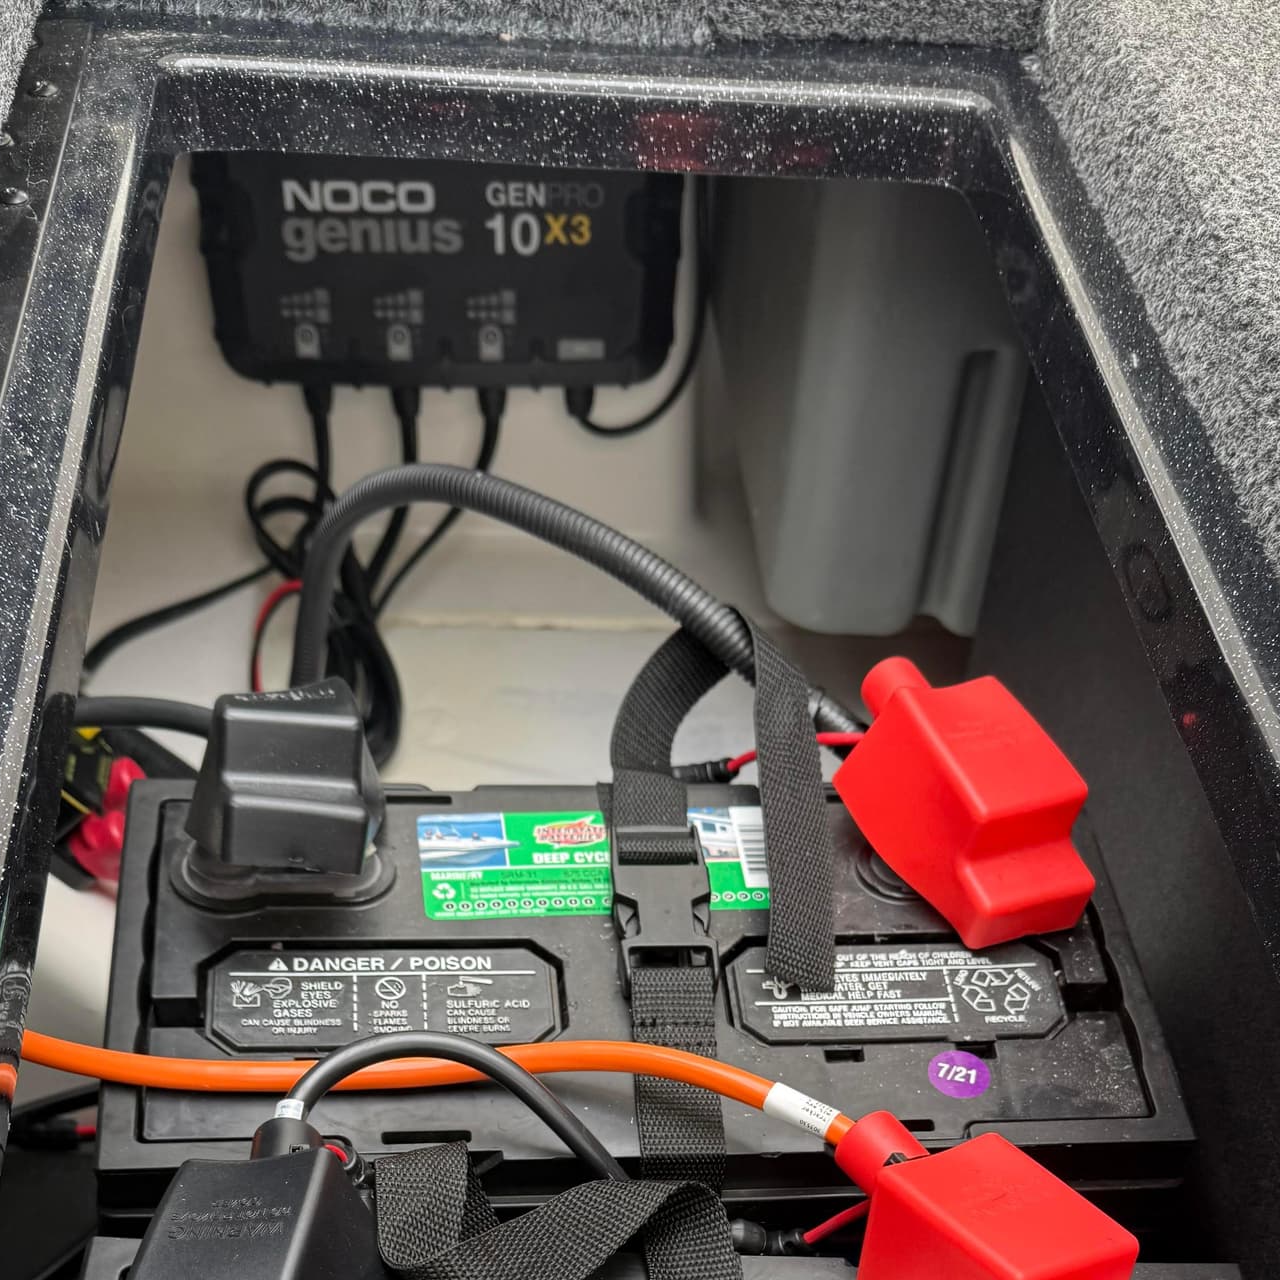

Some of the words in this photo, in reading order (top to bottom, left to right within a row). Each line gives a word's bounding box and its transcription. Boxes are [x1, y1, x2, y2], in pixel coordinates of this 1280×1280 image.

[282, 180, 435, 213] NOCO
[282, 217, 462, 262] genius
[533, 853, 569, 864] DEEP
[837, 954, 854, 962] OUT
[870, 953, 886, 961] THE
[889, 952, 915, 960] REACH
[293, 957, 384, 971] DANGER
[410, 957, 492, 970] POISON
[897, 959, 919, 967] CAPS
[835, 974, 859, 982] EYES
[862, 972, 927, 981] IMMEDIATELY
[301, 981, 343, 990] SHIELD
[869, 982, 888, 990] GET
[301, 991, 331, 999] EYES
[801, 991, 845, 1001] MEDICAL
[848, 991, 874, 999] HELP
[877, 990, 902, 999] FAST
[273, 1000, 337, 1009] EXPLOSIVE
[381, 1001, 399, 1009] NO
[447, 1000, 500, 1008] SULFURIC
[504, 1000, 530, 1008] ACID
[273, 1009, 312, 1018] GASES
[843, 1011, 874, 1019] VEHICLE
[802, 1019, 842, 1027] AVAILABLE
[985, 1015, 1026, 1023] RECYCLE
[936, 1062, 977, 1085] 7/21
